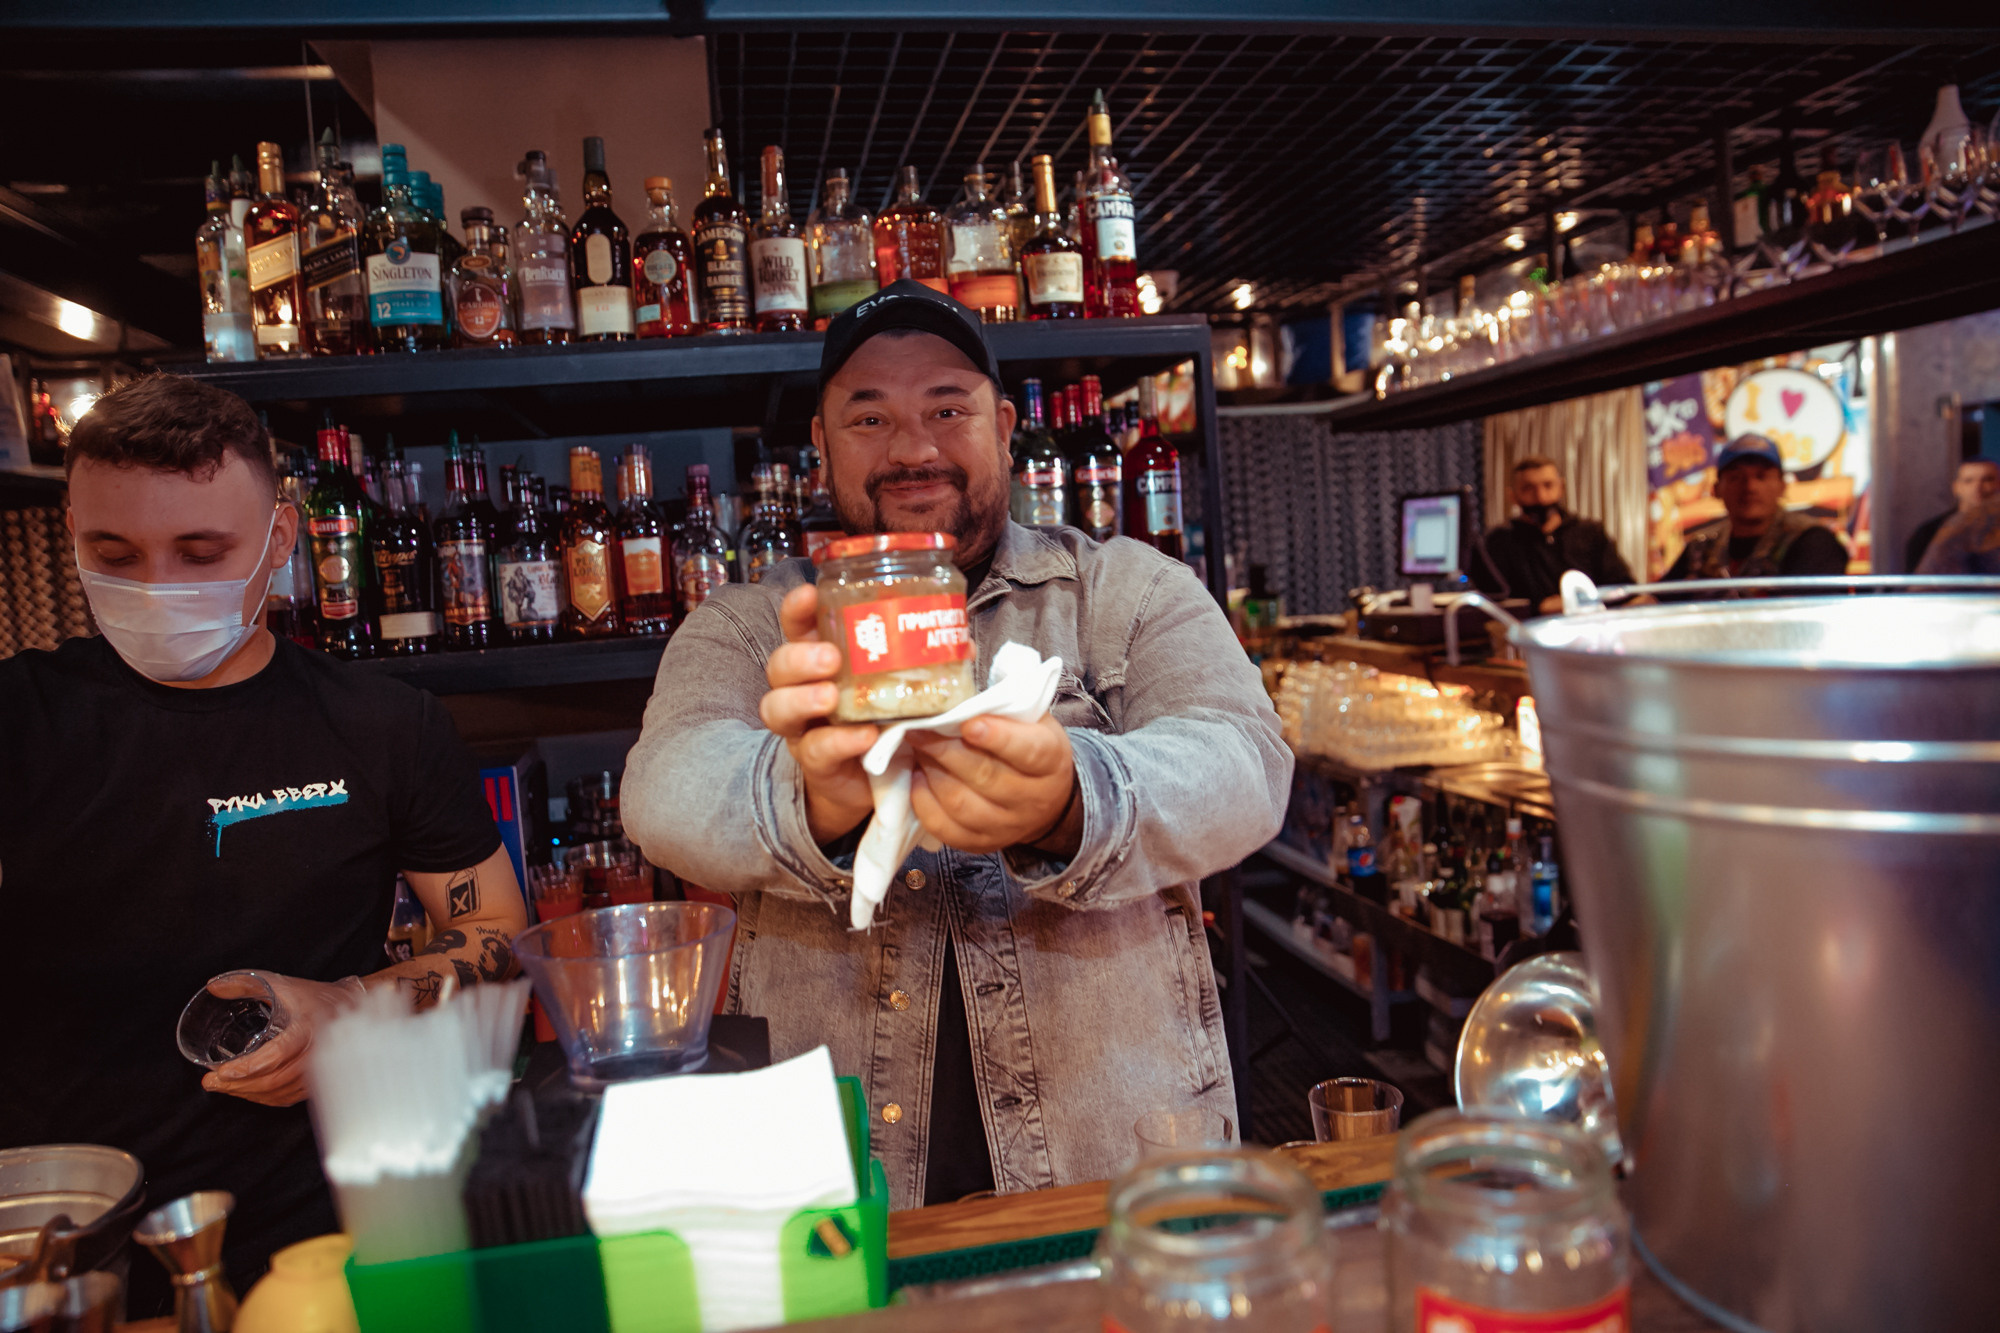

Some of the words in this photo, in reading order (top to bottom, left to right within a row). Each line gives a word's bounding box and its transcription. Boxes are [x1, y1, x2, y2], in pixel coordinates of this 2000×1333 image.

[697, 228, 745, 246] JAMESON
[304, 258, 328, 273] BLACK
[330, 247, 354, 262] LABEL
[762, 256, 794, 269] WILD
[372, 266, 432, 282] SINGLETON
[759, 269, 799, 284] TURKEY
[375, 302, 392, 320] 12
[206, 792, 267, 815] РУКИ
[272, 778, 349, 805] ВВЕРХ
